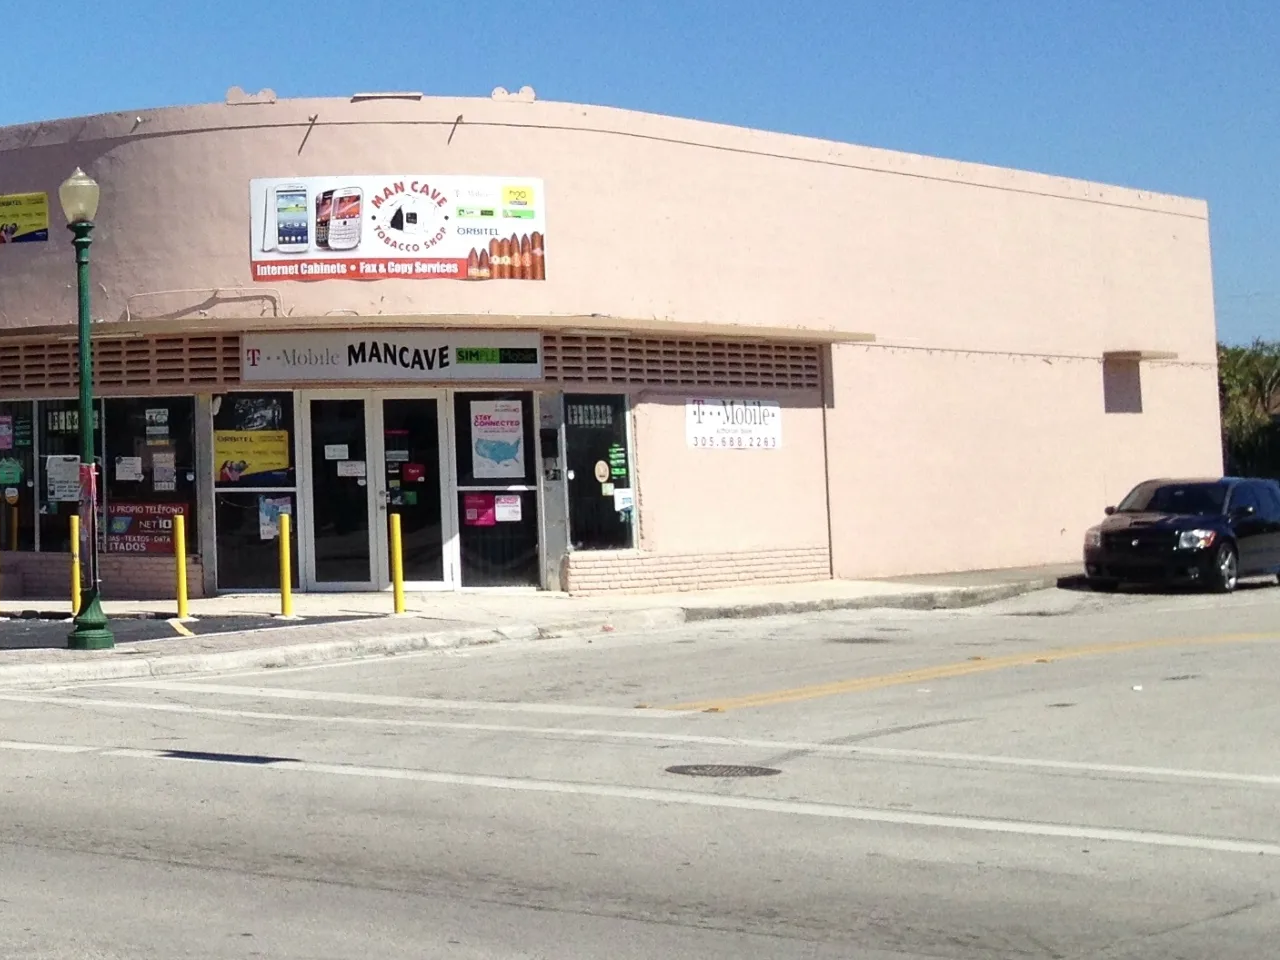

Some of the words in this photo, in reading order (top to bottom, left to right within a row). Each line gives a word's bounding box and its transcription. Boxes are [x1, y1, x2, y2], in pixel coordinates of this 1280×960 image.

[371, 181, 405, 209] MAN
[411, 180, 448, 207] CAVE
[374, 225, 420, 252] TOBACCO
[423, 226, 448, 249] SHOP
[457, 227, 499, 236] ORBITEL
[256, 264, 299, 276] Internet
[300, 262, 347, 275] Cabinets
[359, 262, 377, 274] Fax
[388, 262, 414, 277] Copy
[414, 261, 459, 274] Services
[347, 341, 450, 371] MANCAVE
[457, 349, 497, 362] SIMPLE
[116, 505, 144, 514] PROPIO
[125, 534, 150, 543] TEXTOS
